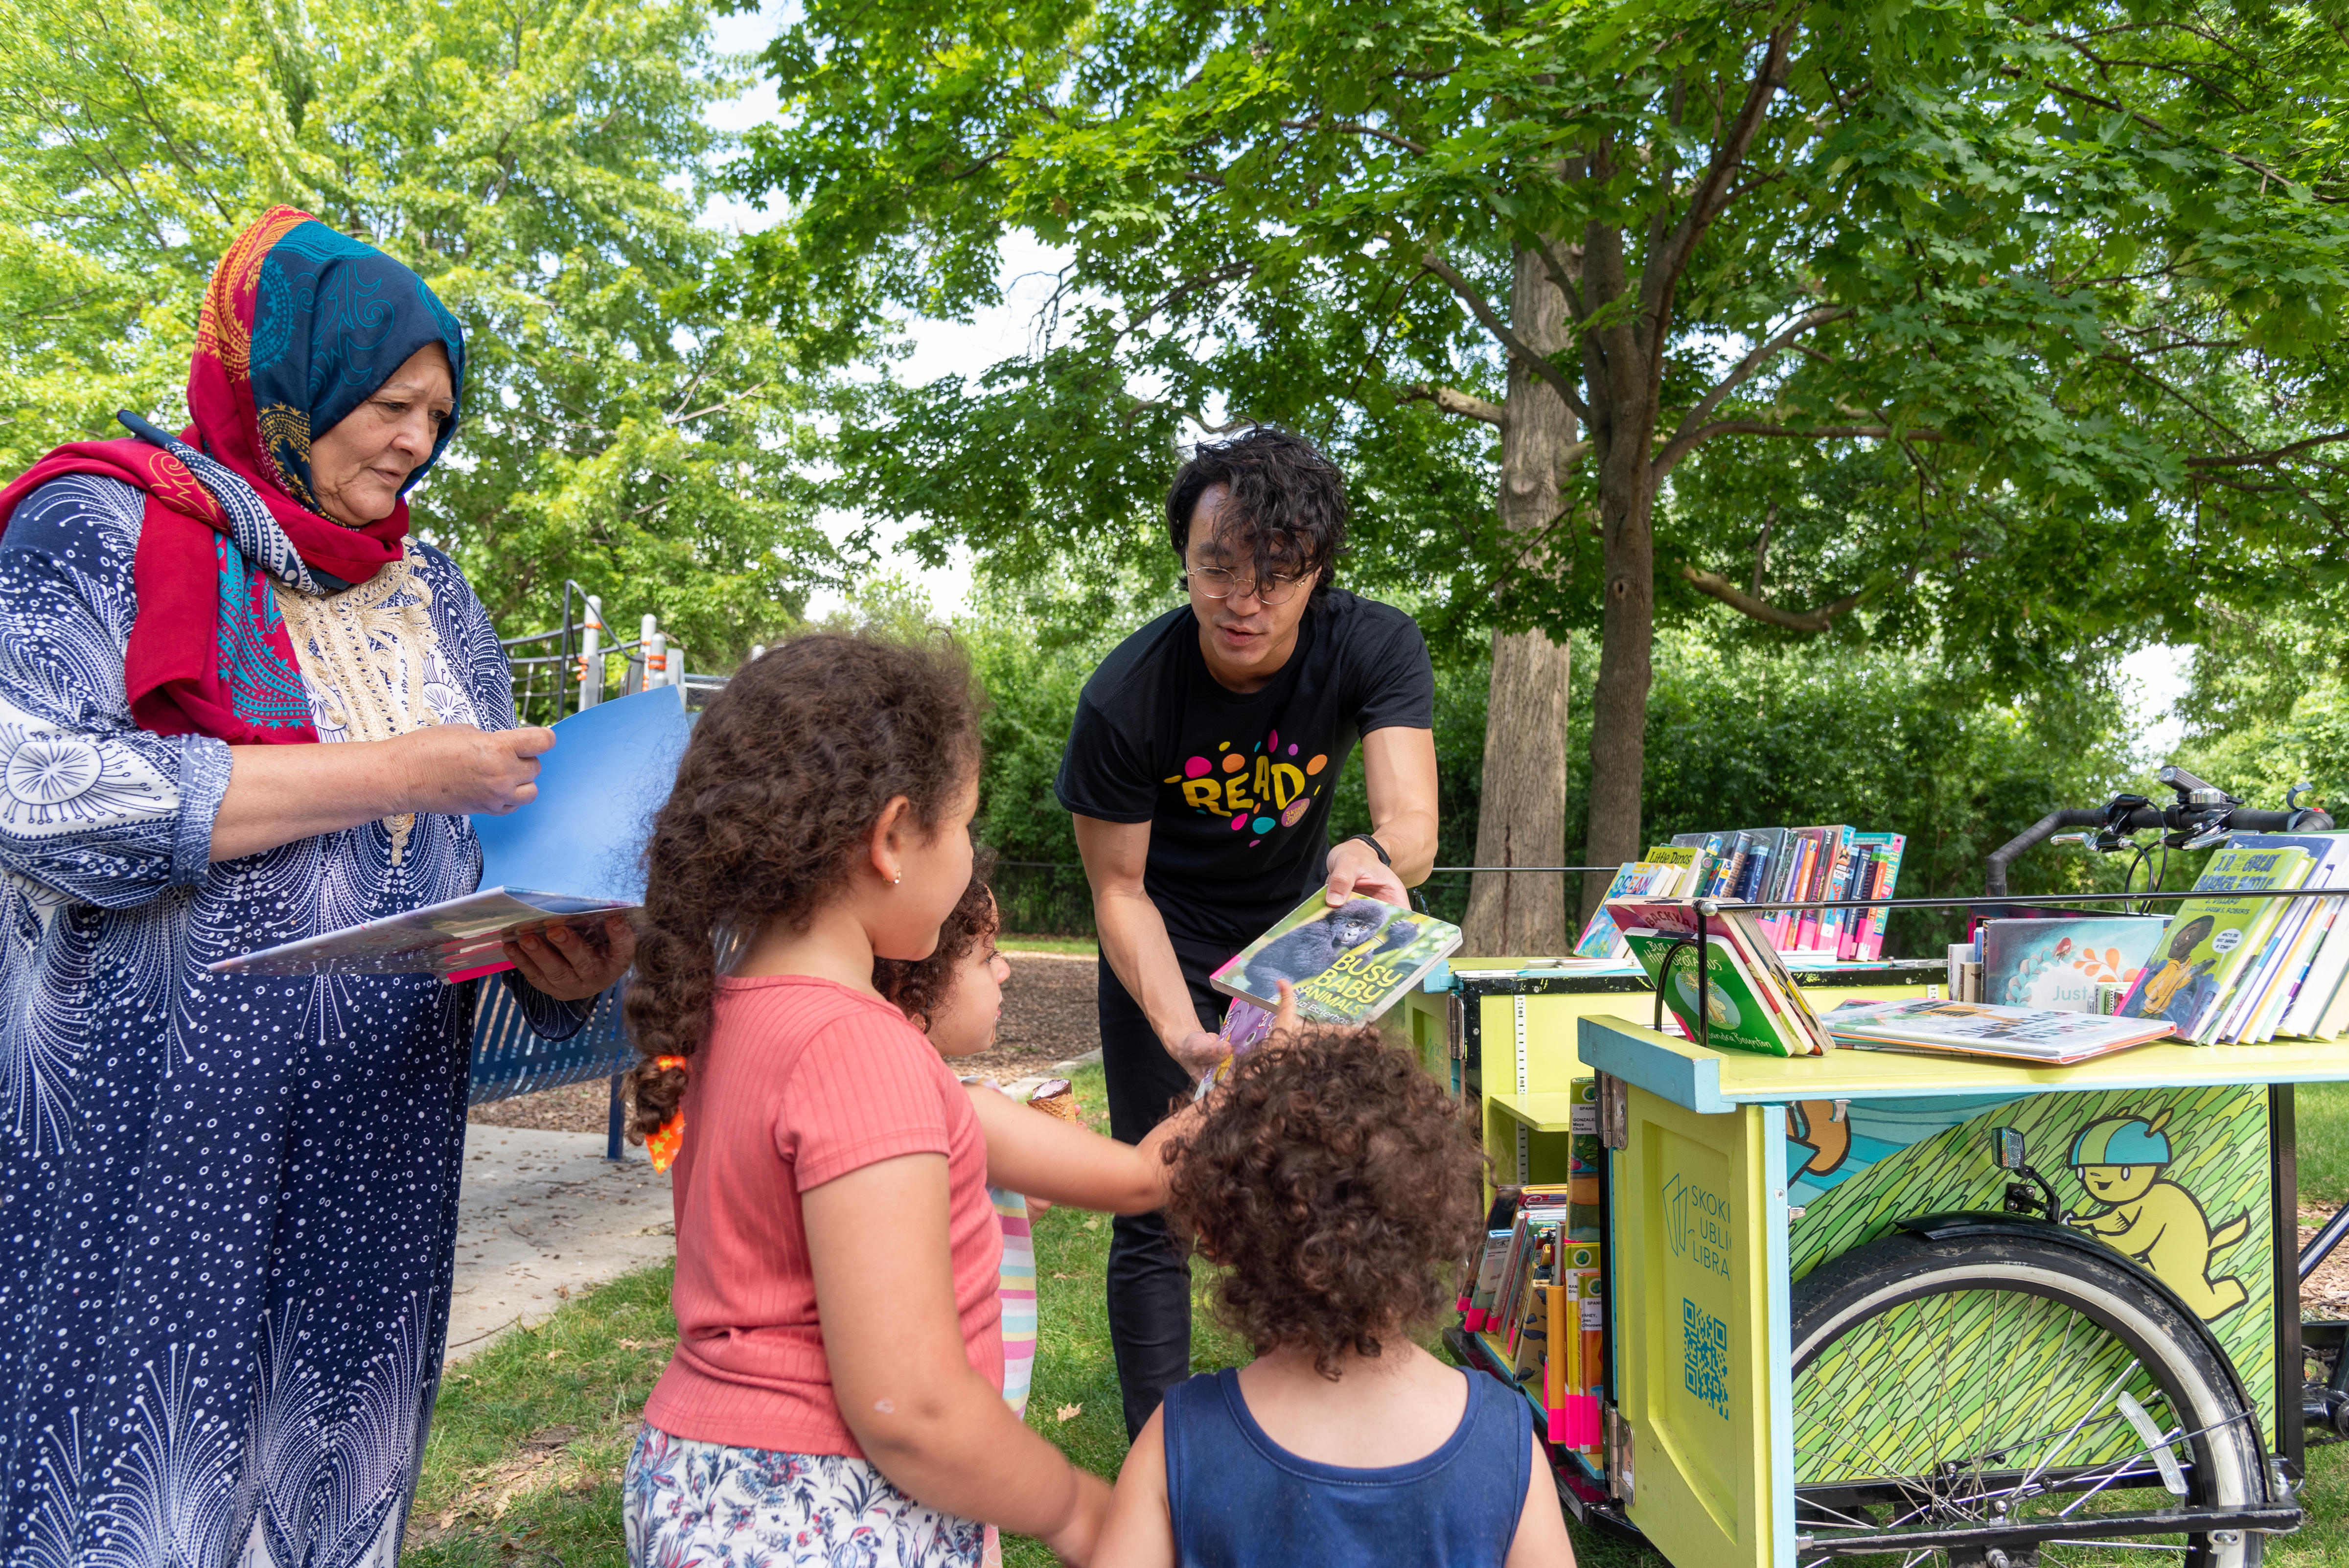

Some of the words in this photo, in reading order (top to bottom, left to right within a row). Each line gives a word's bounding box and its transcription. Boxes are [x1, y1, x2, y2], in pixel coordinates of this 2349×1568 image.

[1182, 756, 1305, 817] READ
[1286, 801, 1306, 817] SKOKIE
[1649, 852, 1669, 863] Little
[1670, 852, 1693, 865] Dinos
[1727, 852, 1745, 887] CHARLIE
[1612, 875, 1653, 894] OCEAN
[1883, 864, 1897, 885] FAKE
[1646, 941, 1666, 952] BUT
[1331, 953, 1404, 987] BUSY
[1313, 968, 1385, 1003] BABY
[2052, 986, 2088, 1001] Just
[1293, 996, 1310, 1008] Suzi
[1307, 1004, 1350, 1025] Eszterhas
[1300, 985, 1364, 1015] ANIMALS
[1943, 1012, 2072, 1036] BUTTERFLY
[2016, 1020, 2110, 1038] DIGGER
[1731, 1032, 1772, 1049] Boynton
[1692, 1185, 1730, 1223] SKOKI
[1688, 1217, 1731, 1251] UBLI
[1693, 1240, 1730, 1281] LIBRA
